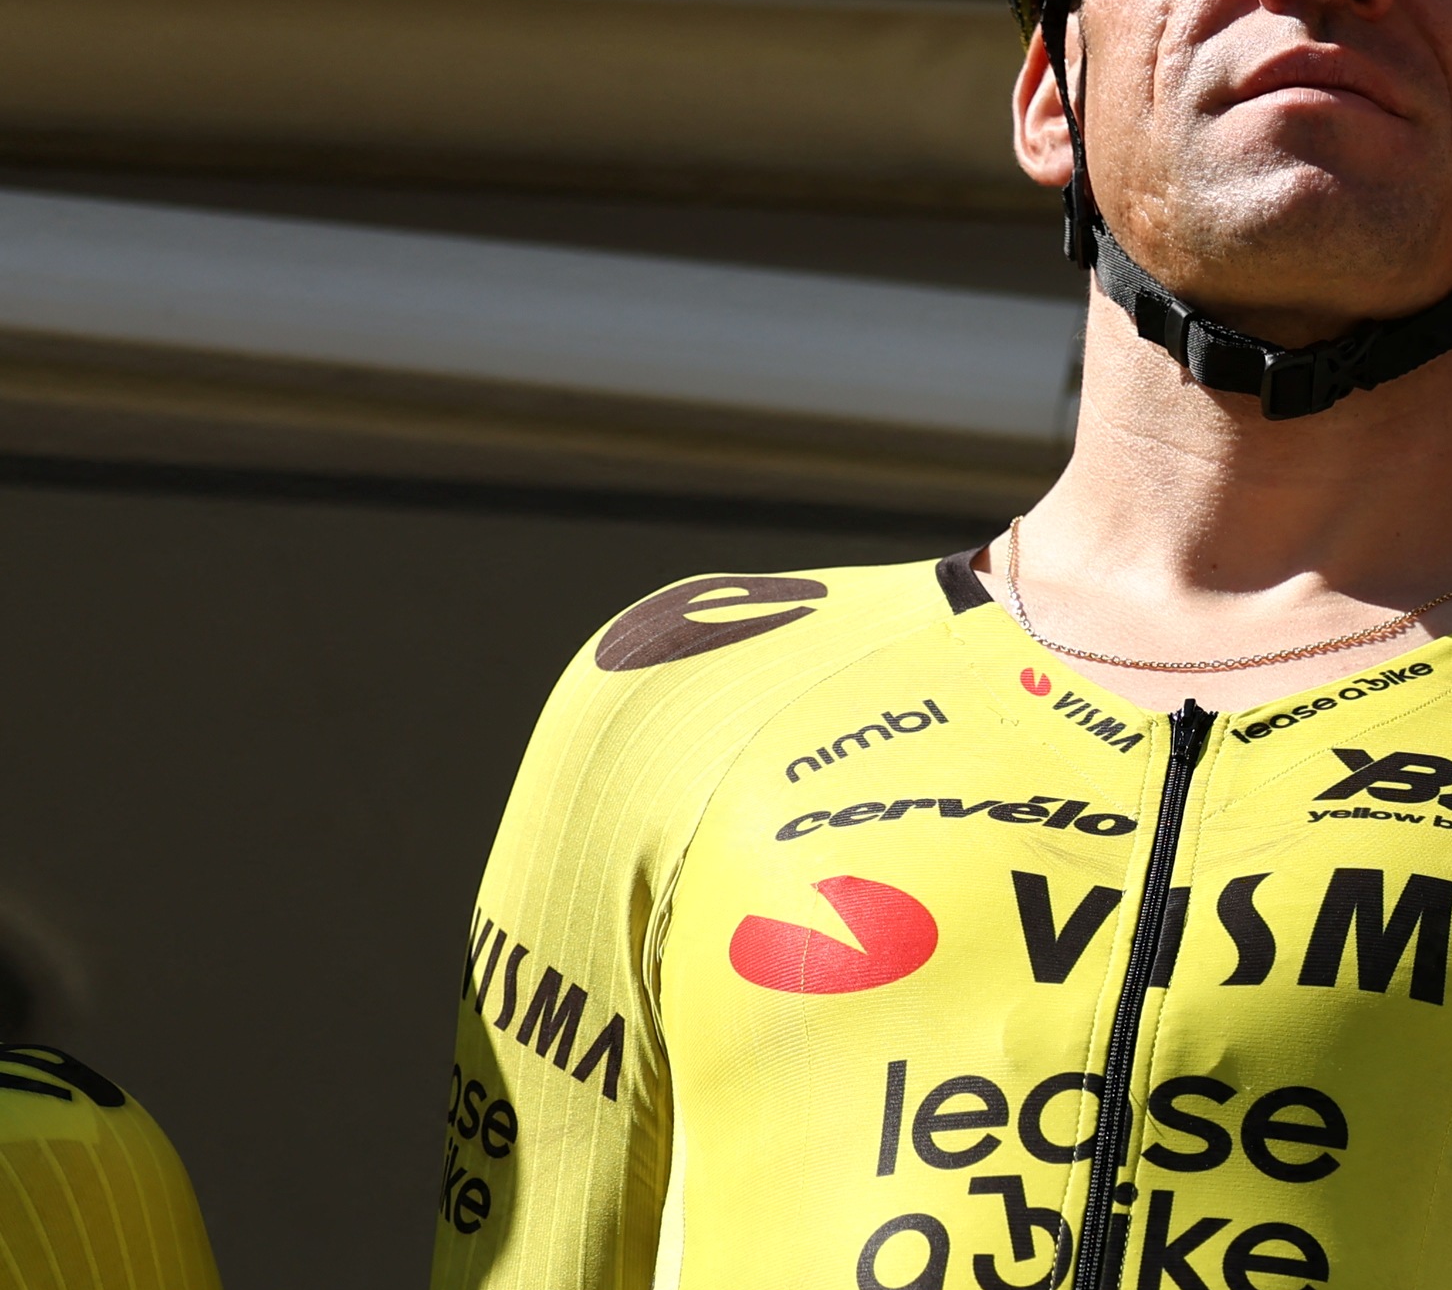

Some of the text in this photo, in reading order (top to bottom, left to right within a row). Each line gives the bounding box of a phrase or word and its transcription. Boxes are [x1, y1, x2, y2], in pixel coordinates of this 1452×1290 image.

[785, 699, 950, 784] nimbl
[1051, 690, 1145, 755] VISMA
[1230, 695, 1338, 745] lease
[775, 795, 1138, 842] cervélo
[1306, 807, 1426, 824] yellow
[875, 1059, 1349, 1184] lease
